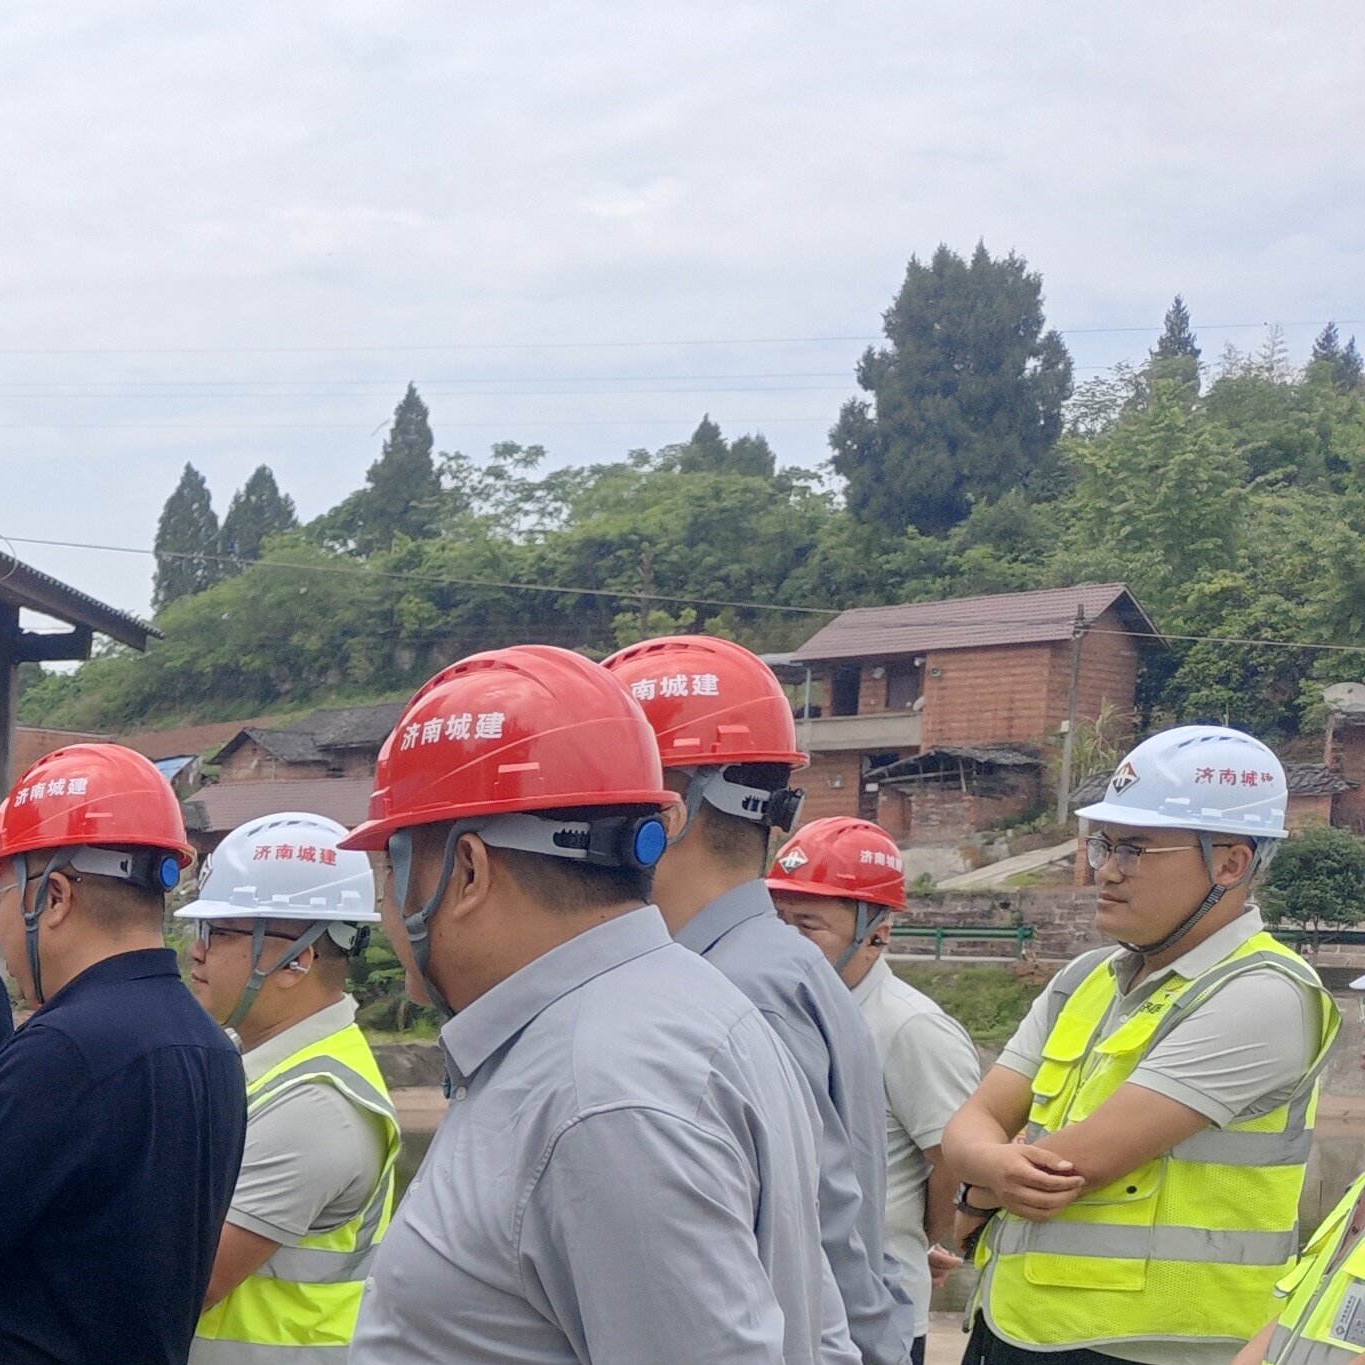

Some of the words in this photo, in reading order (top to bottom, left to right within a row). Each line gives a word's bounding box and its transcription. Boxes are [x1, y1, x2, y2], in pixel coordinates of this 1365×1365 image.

[400, 711, 506, 751] 济南城建
[13, 777, 89, 808] 济南城建
[252, 843, 338, 867] 济南城建
